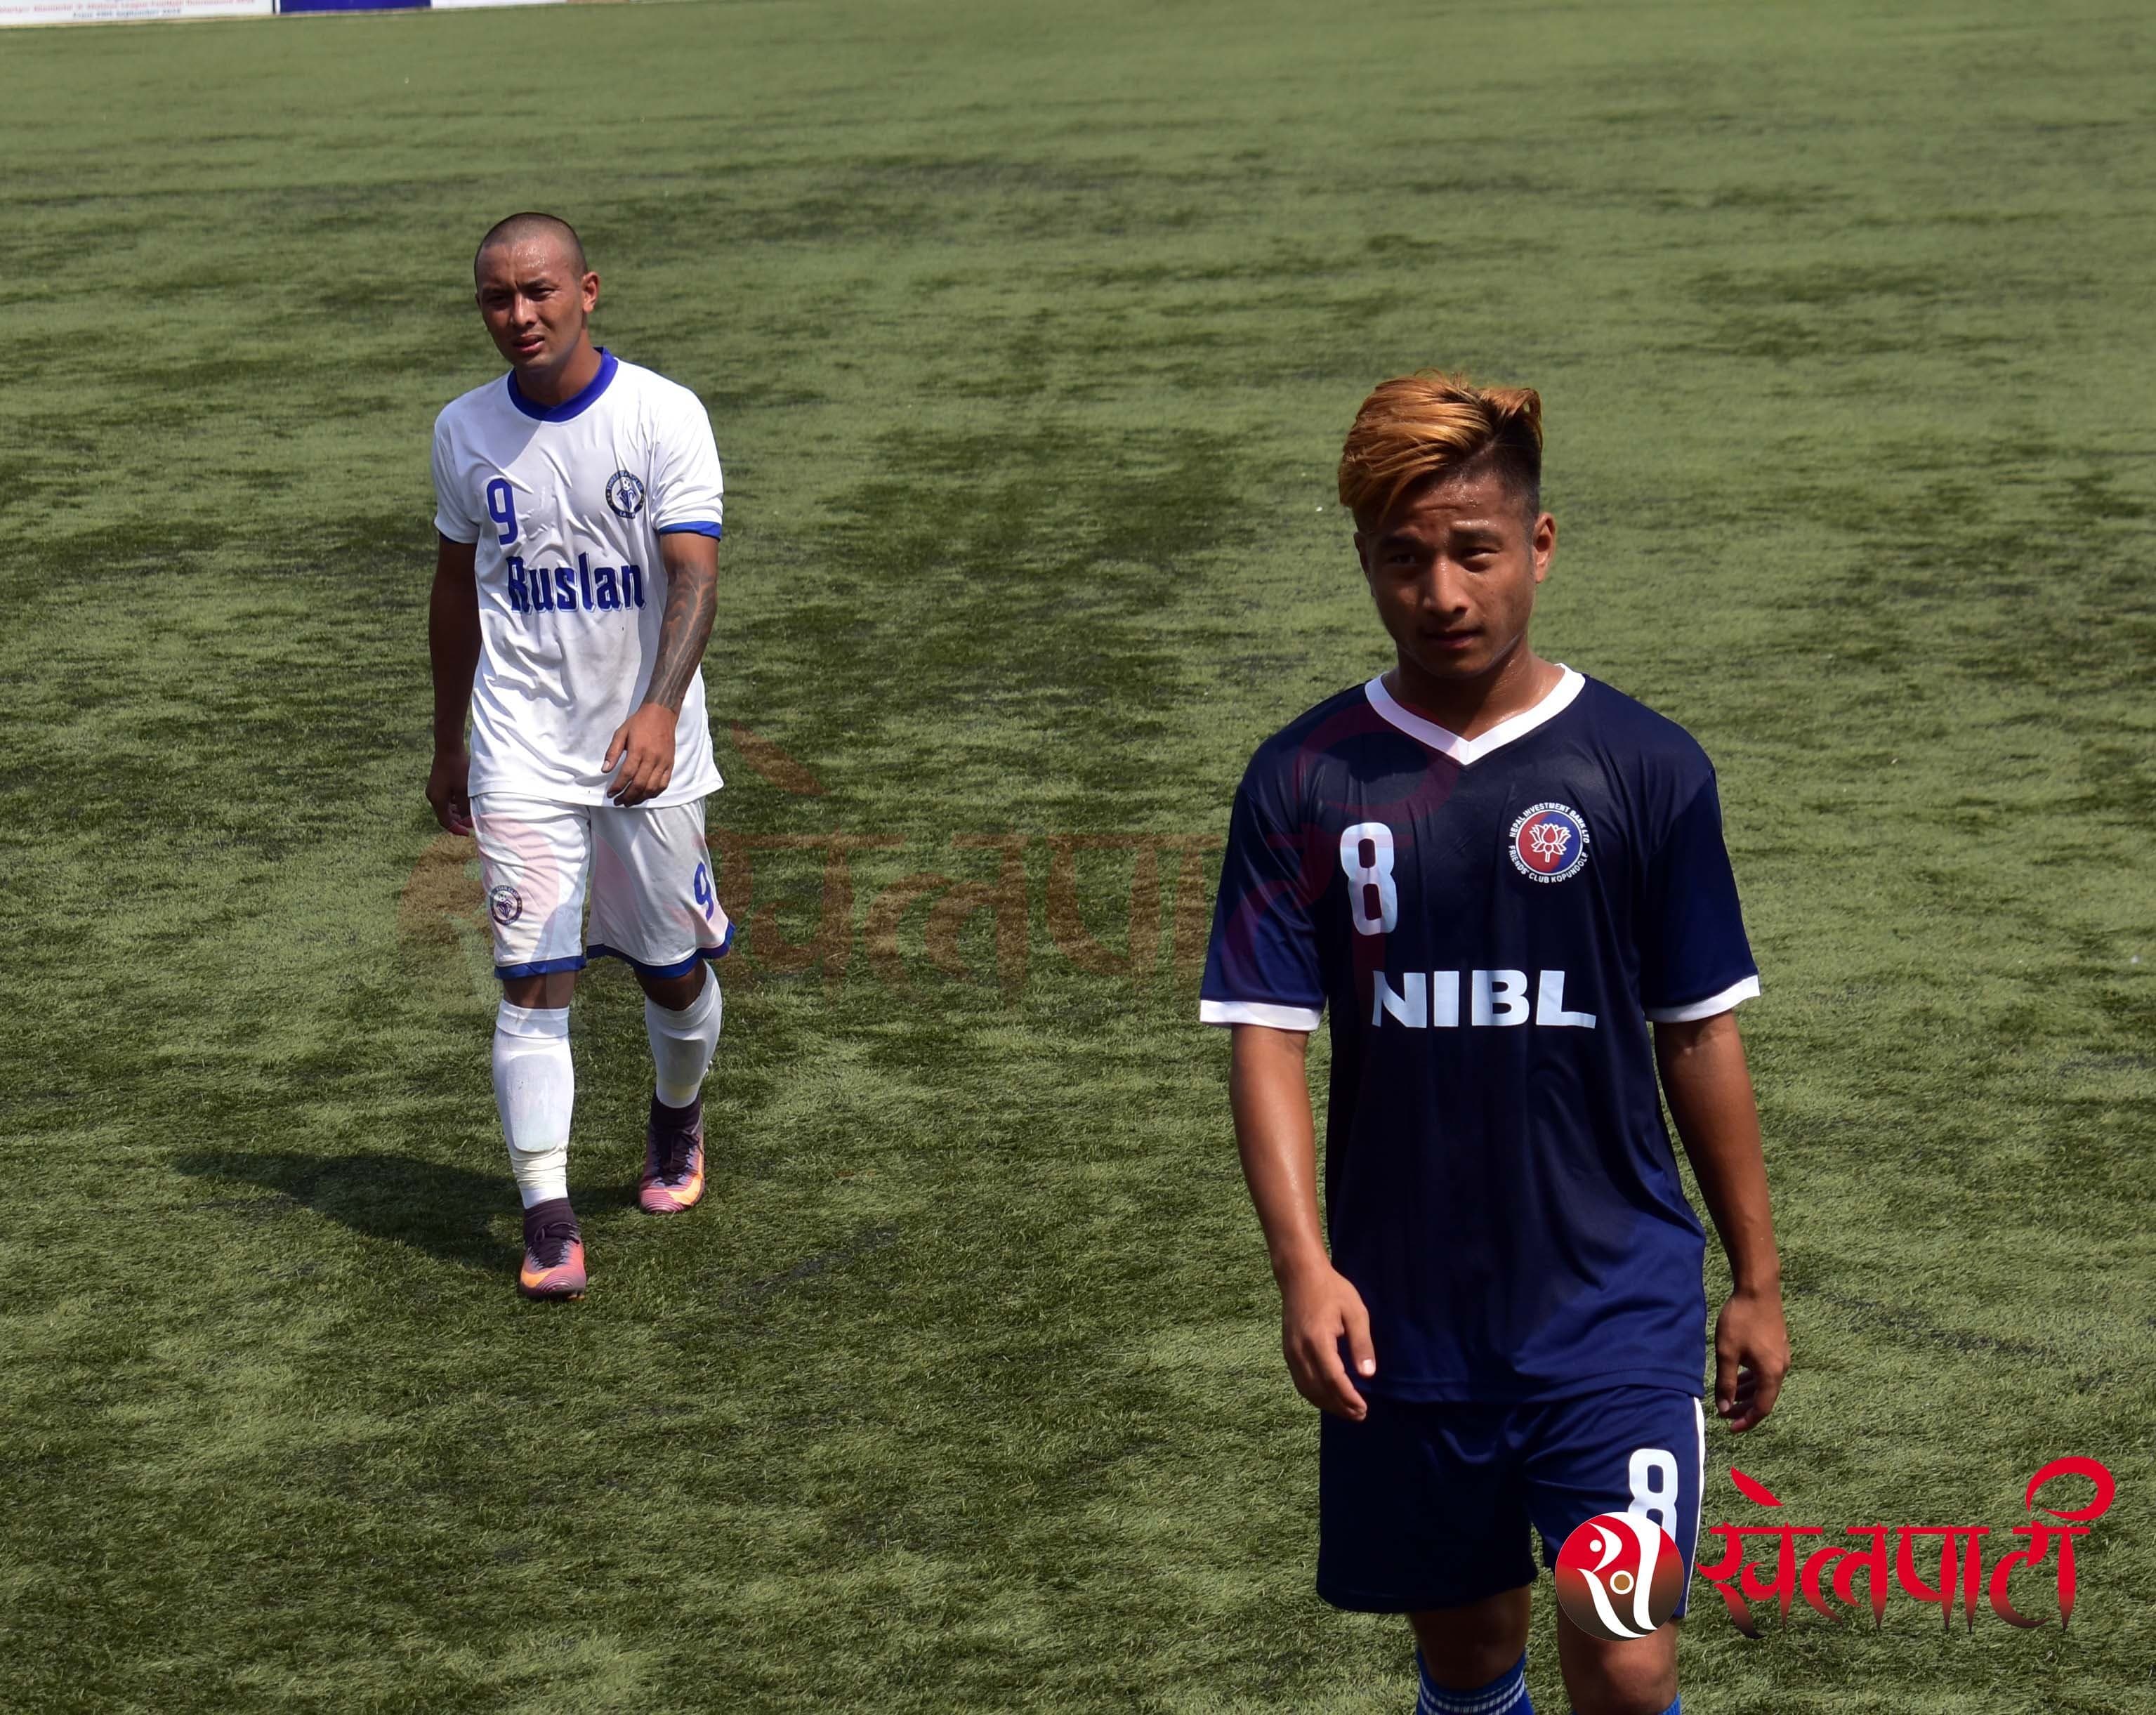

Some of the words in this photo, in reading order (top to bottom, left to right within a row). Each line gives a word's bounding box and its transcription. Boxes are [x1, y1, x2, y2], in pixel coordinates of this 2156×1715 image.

[486, 478, 519, 545] 9
[507, 552, 647, 615] Ruslan
[1508, 815, 1526, 838] NEPAL
[1524, 802, 1571, 817] INVESTMENT
[1569, 809, 1586, 829] BANK
[694, 862, 714, 922] 9
[1339, 822, 1398, 935] 8
[1528, 872, 1550, 883] CLUB
[1551, 851, 1589, 883] KOPUNDOLE
[1372, 969, 1597, 1029] NIBL
[1628, 1448, 1678, 1539] 8
